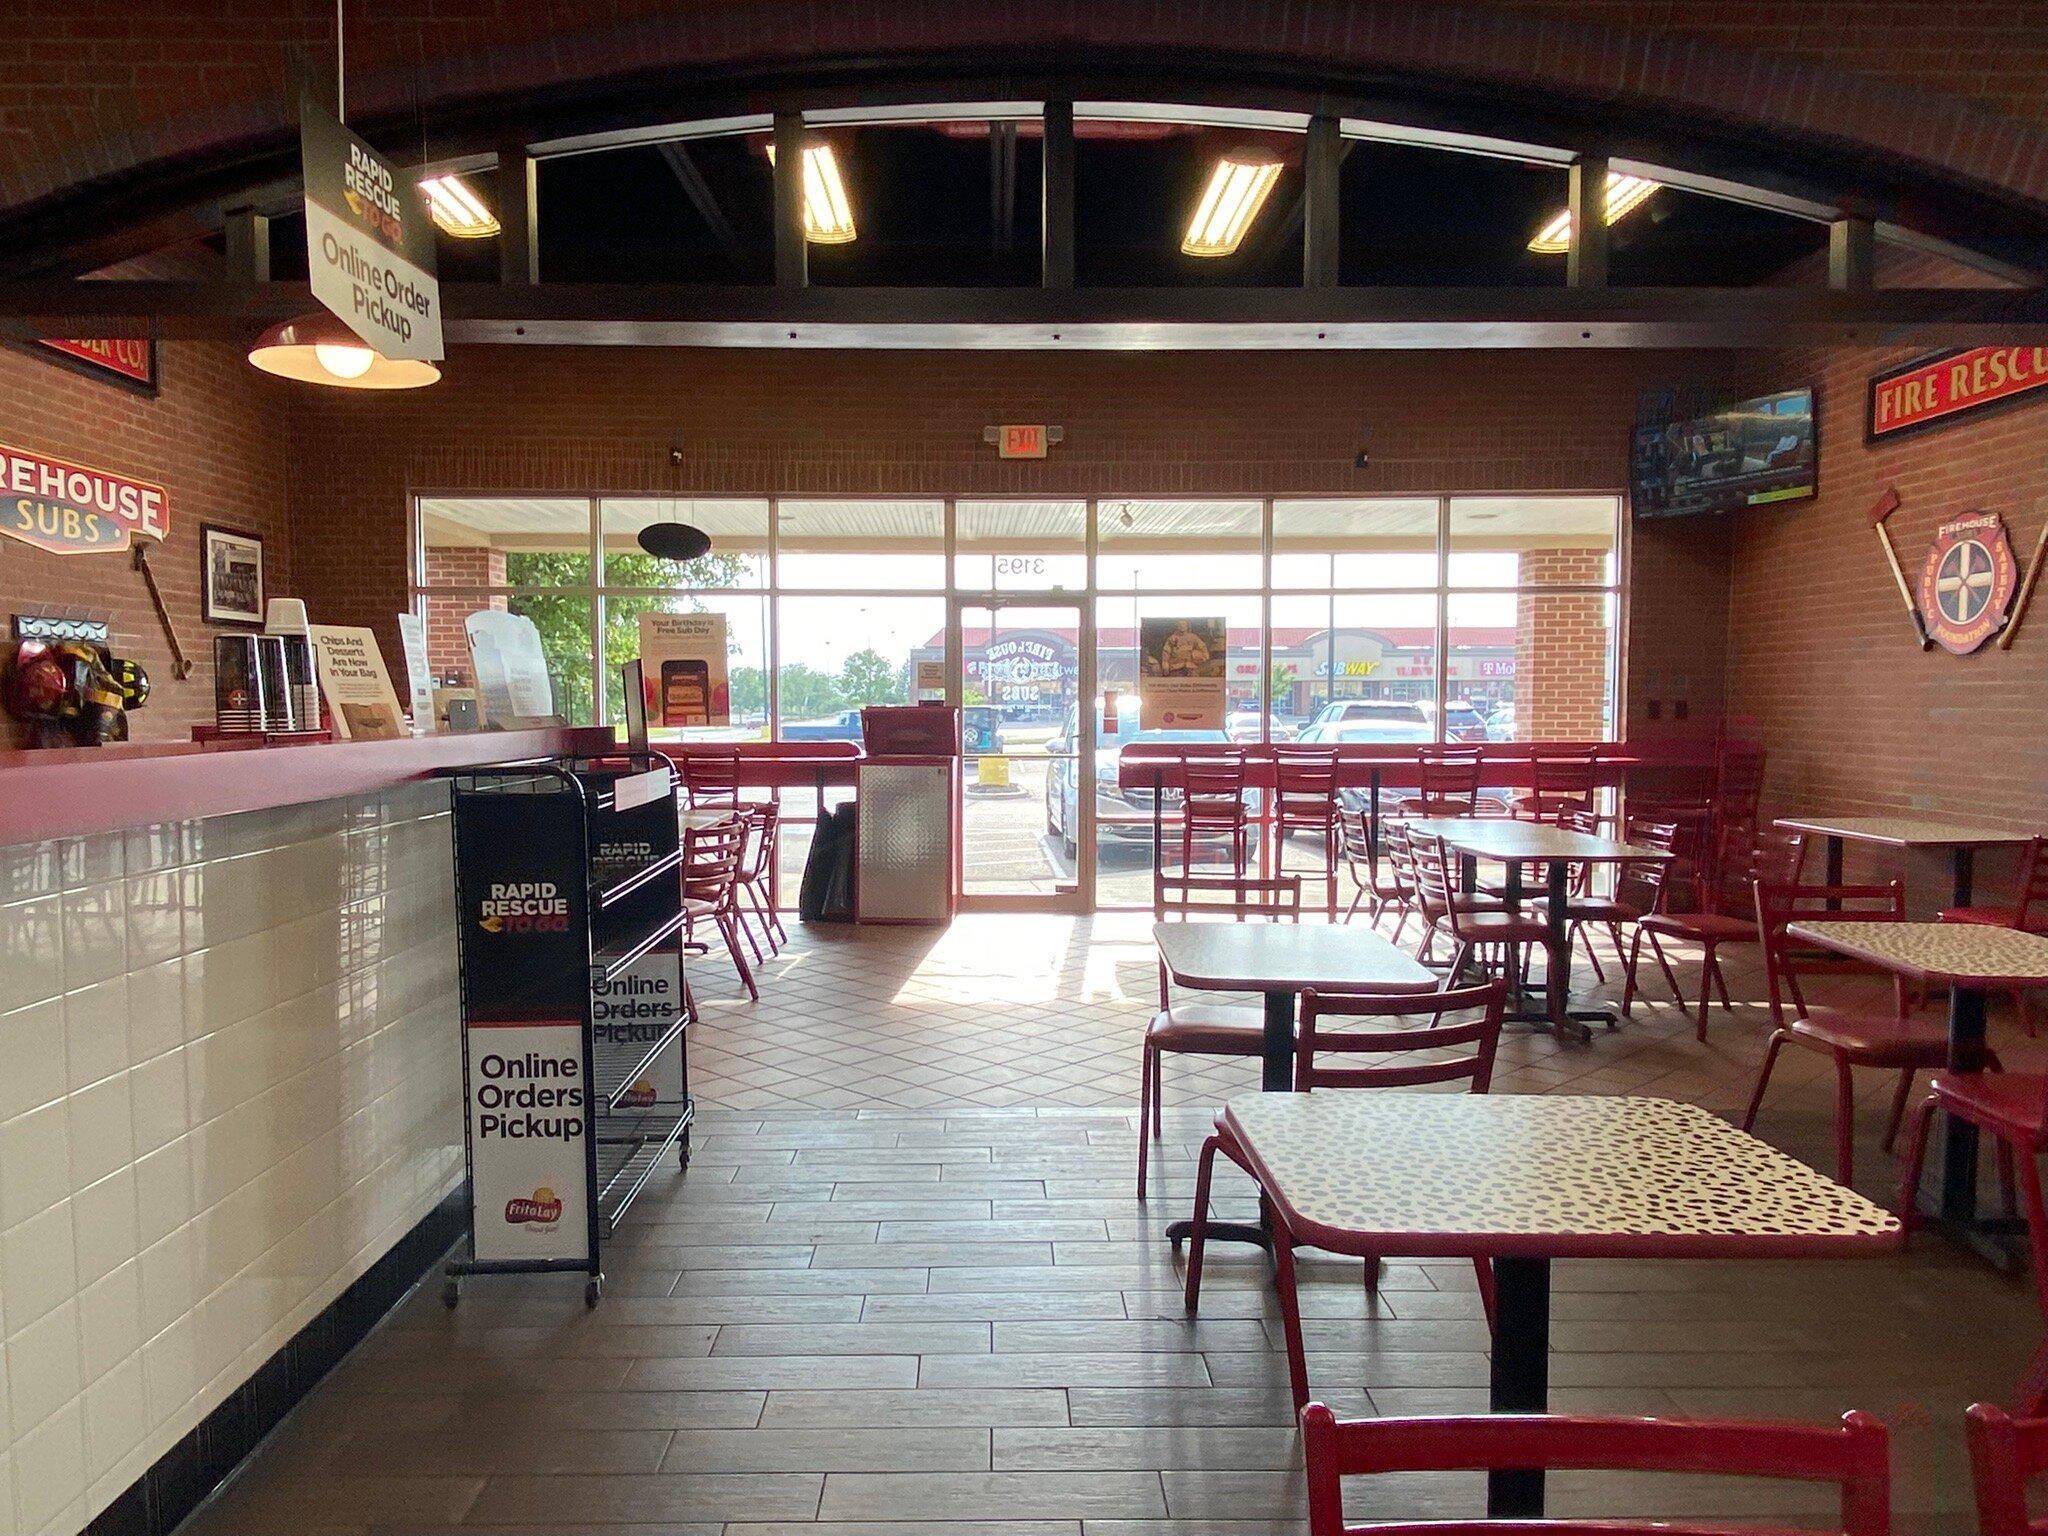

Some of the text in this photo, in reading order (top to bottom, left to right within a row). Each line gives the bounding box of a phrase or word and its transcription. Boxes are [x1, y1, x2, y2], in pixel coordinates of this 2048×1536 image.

[350, 142, 393, 193] RAPID
[344, 161, 401, 222] RESCUE
[322, 232, 431, 318] Online Order
[352, 283, 412, 344] Pickup
[1881, 374, 1939, 423] FIRE
[16, 500, 98, 543] SUBS
[1938, 515, 1997, 540] FIREHOUSE
[1993, 541, 2009, 610] SAFETY
[320, 635, 363, 646] Chips And
[327, 646, 366, 656] Desserts
[333, 657, 368, 666] Are Now
[340, 667, 358, 677] Your
[360, 668, 378, 679] Bag
[1315, 661, 1381, 676] SUBWAY
[599, 842, 652, 856] RAPID
[490, 882, 557, 900] RAPID
[481, 898, 568, 917] RESCUE
[592, 975, 669, 996] Online
[592, 998, 673, 1020] Orders
[480, 1053, 579, 1079] Online
[477, 1083, 583, 1109] Orders
[480, 1113, 583, 1142] Pickup
